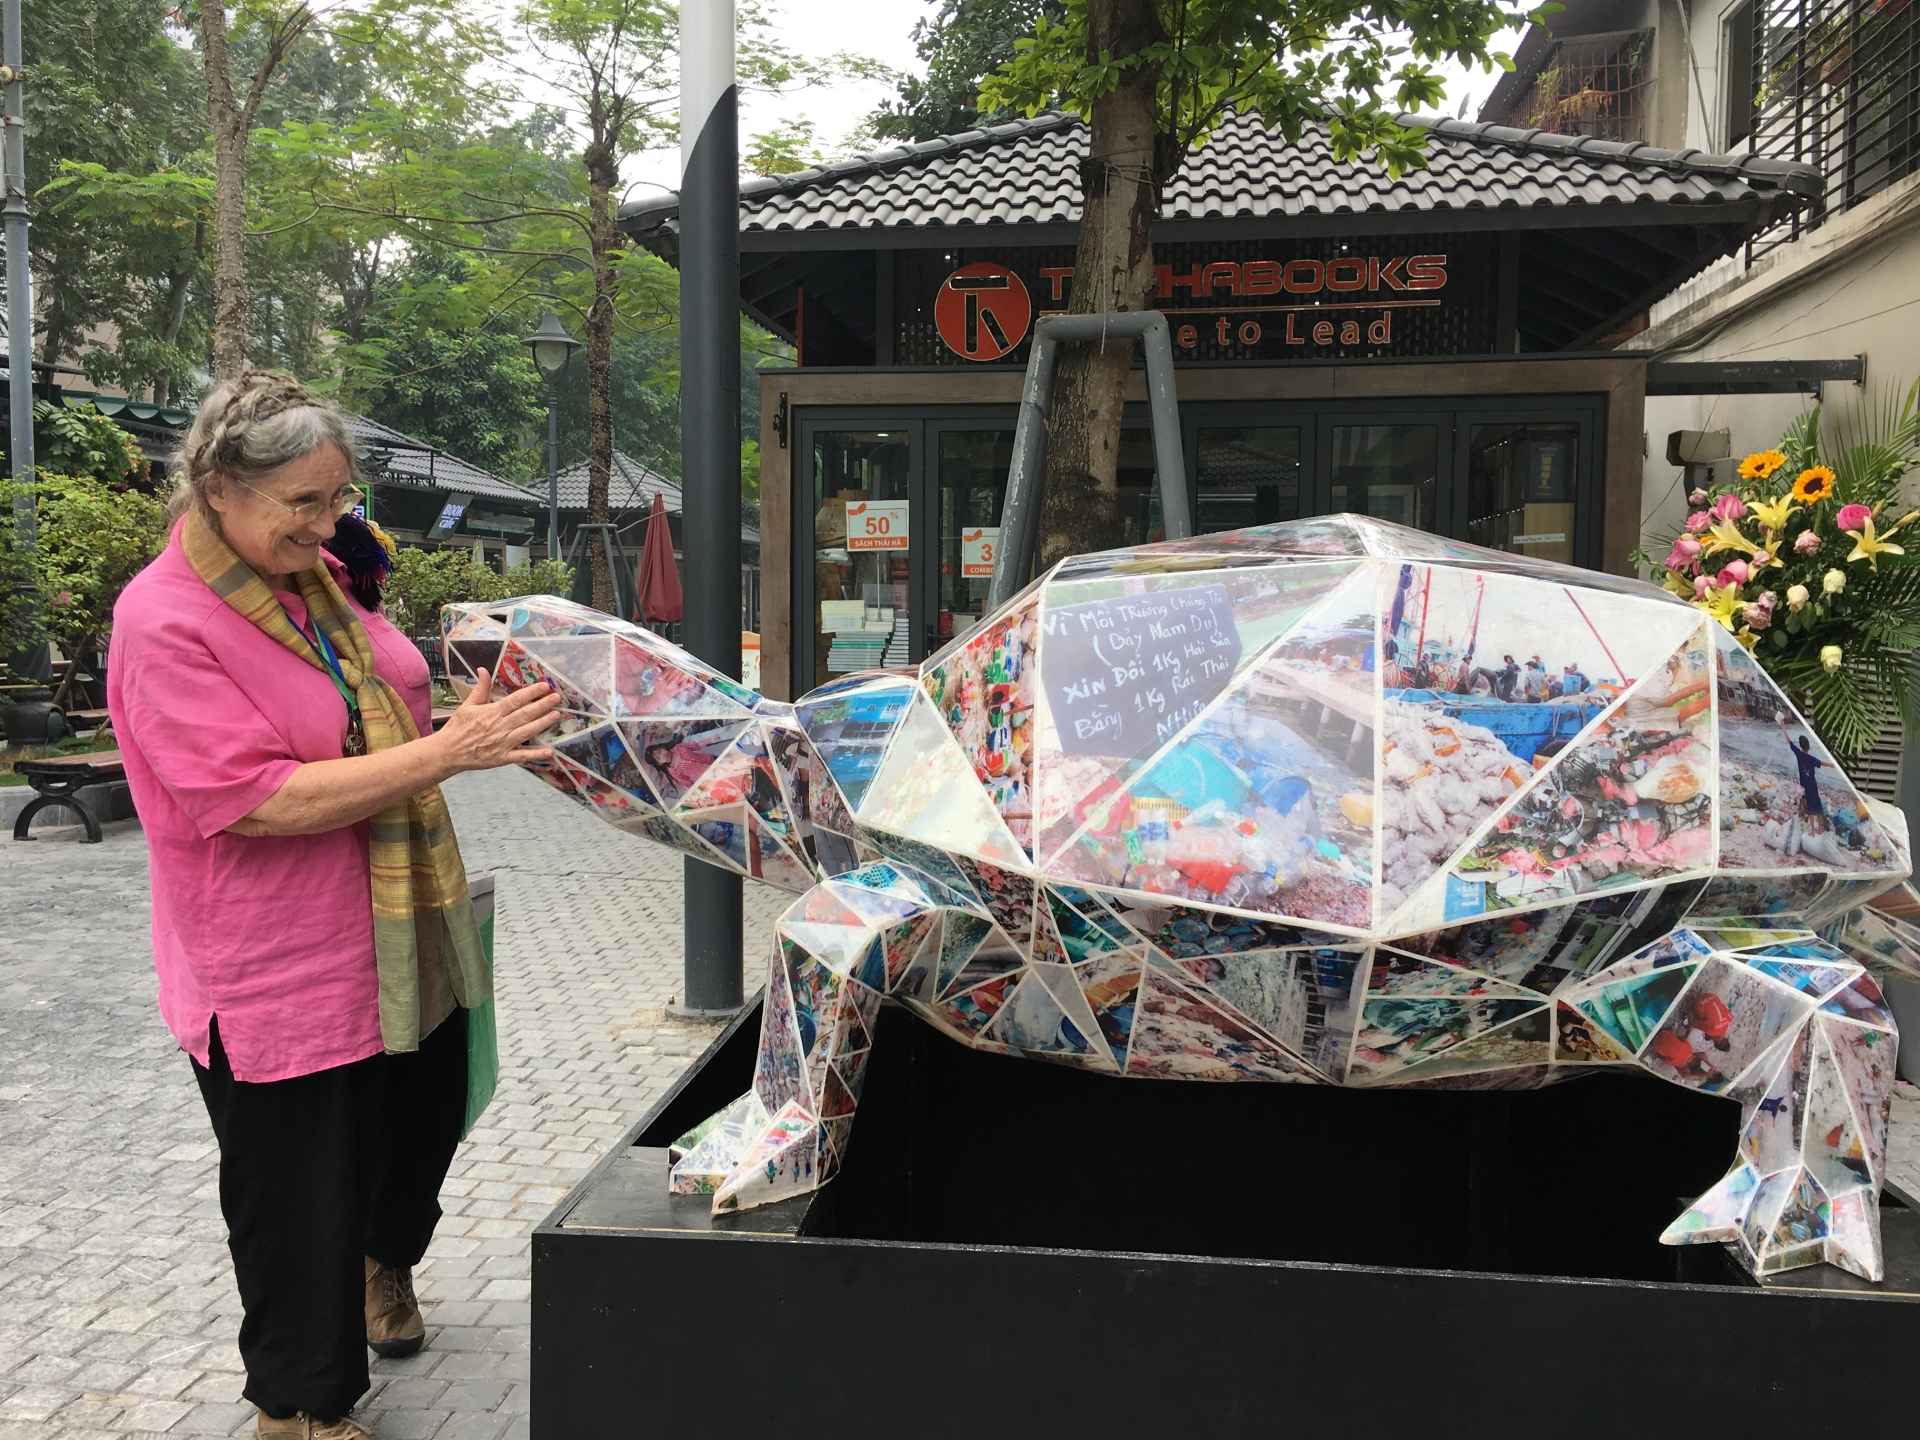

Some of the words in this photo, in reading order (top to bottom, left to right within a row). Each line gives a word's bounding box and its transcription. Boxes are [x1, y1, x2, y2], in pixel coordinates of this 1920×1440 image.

[1218, 315, 1261, 346] to
[1286, 310, 1392, 346] Lead
[442, 504, 466, 517] BOOK
[855, 539, 873, 548] SÁCH
[874, 538, 891, 547] THÁI
[1148, 621, 1186, 641] Nam
